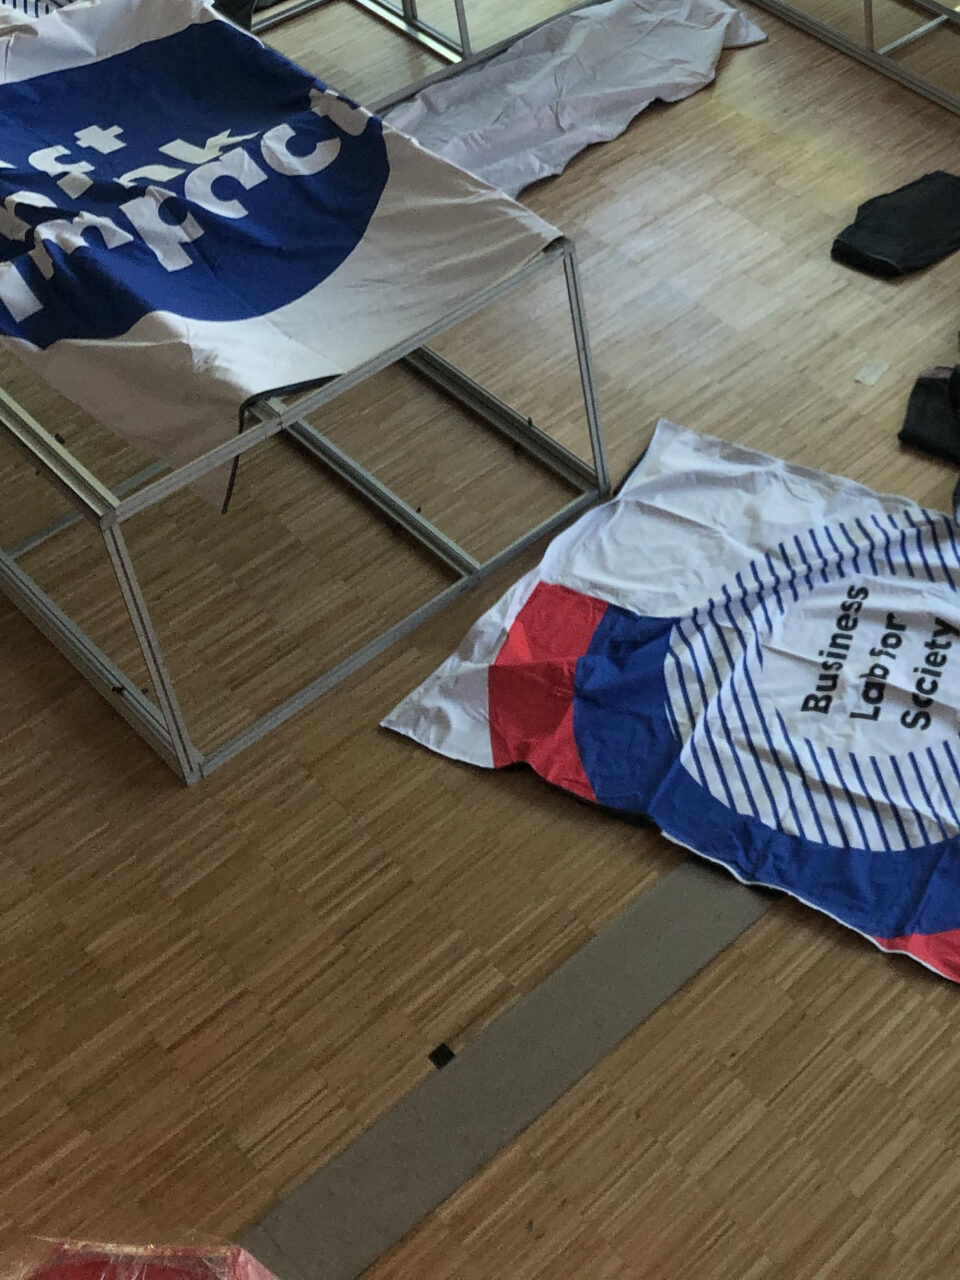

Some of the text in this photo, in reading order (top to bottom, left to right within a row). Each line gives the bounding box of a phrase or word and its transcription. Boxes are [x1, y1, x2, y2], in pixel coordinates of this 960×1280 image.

[801, 584, 869, 714] Business
[850, 612, 907, 721] Lab for
[901, 617, 960, 731] Society
